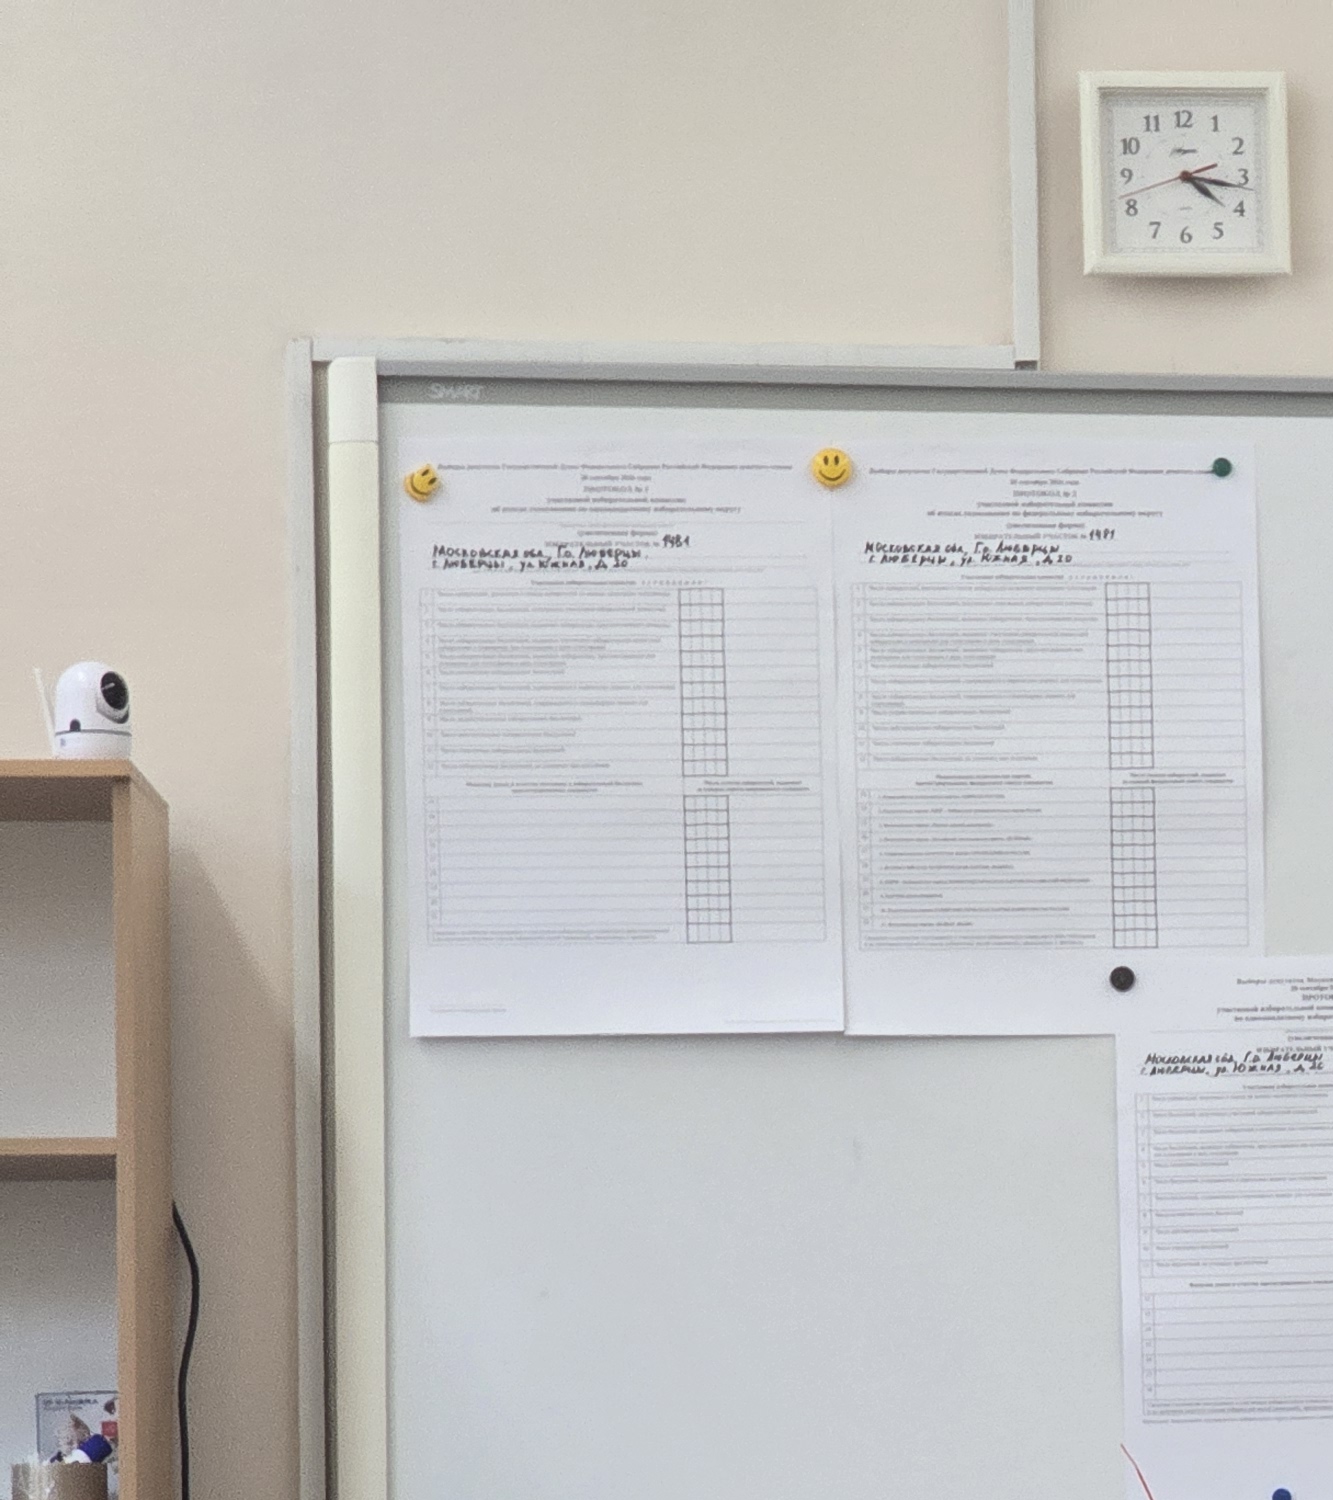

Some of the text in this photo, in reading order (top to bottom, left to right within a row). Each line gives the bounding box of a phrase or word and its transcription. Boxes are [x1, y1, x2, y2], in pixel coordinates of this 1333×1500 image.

[1143, 114, 1161, 132] 11
[1174, 110, 1193, 128] 12
[1211, 115, 1219, 132] 1
[1120, 137, 1140, 155] 10
[1231, 137, 1245, 155] 2
[1120, 168, 1133, 185] 9
[1237, 168, 1249, 186] 3
[1125, 199, 1138, 216] 8
[1232, 200, 1245, 217] 4
[1149, 221, 1161, 239] 7
[1180, 226, 1193, 244] 6
[1212, 222, 1224, 240] 5
